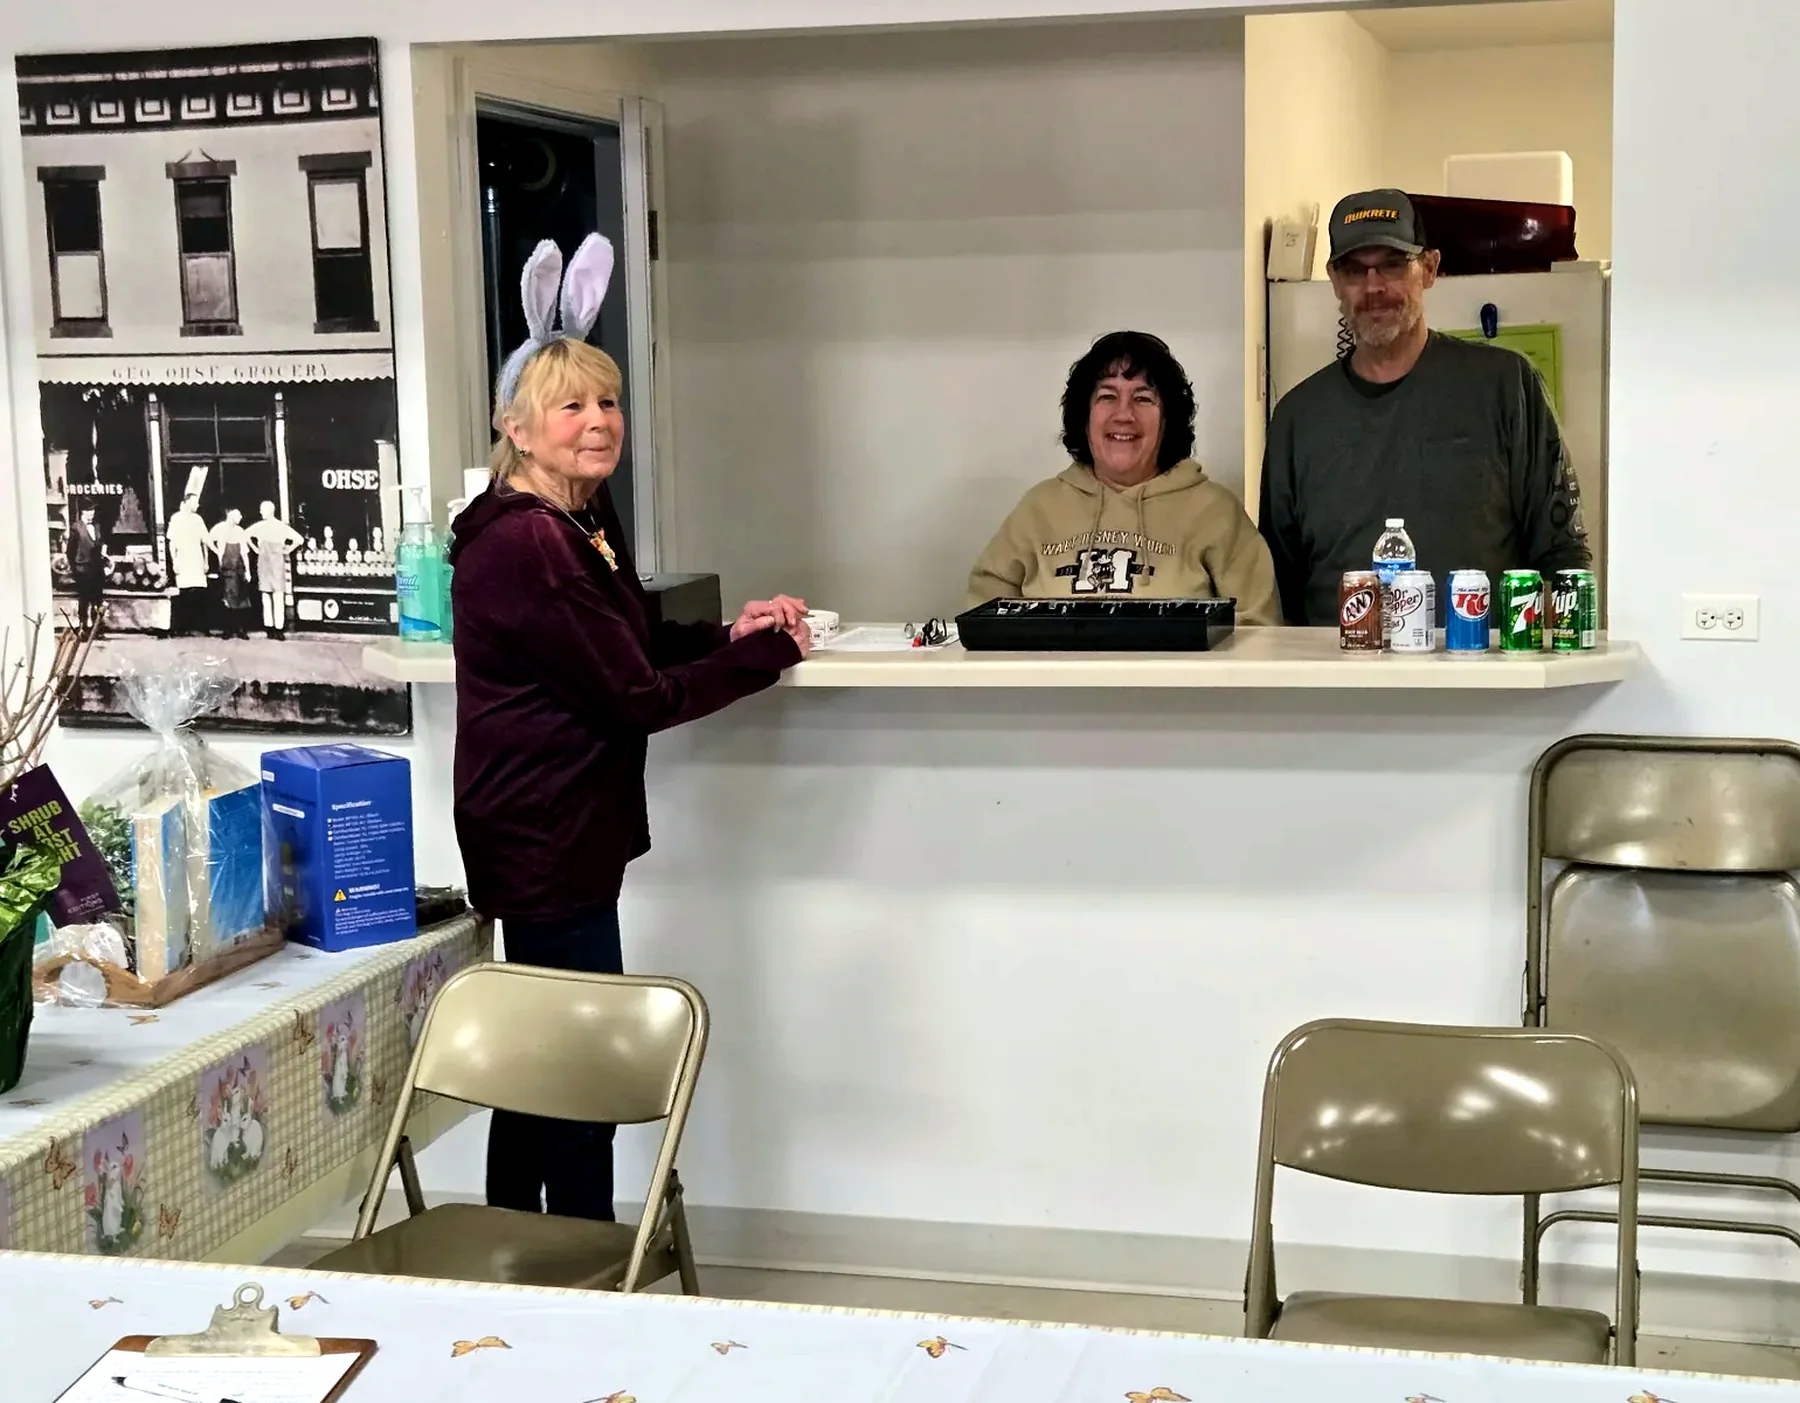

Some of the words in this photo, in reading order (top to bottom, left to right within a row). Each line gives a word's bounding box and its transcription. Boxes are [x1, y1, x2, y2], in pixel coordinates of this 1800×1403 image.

[1343, 208, 1400, 225] QUIKRETE
[112, 367, 150, 379] GEO
[166, 365, 220, 378] OHSE
[234, 363, 329, 378] GROCERY
[322, 469, 379, 490] OHSE
[1042, 535, 1078, 556] WALT
[1394, 588, 1408, 601] Dr
[1455, 593, 1489, 616] RC
[331, 800, 372, 811] Specification
[8, 800, 63, 834] SHRUB
[32, 820, 54, 840] AT
